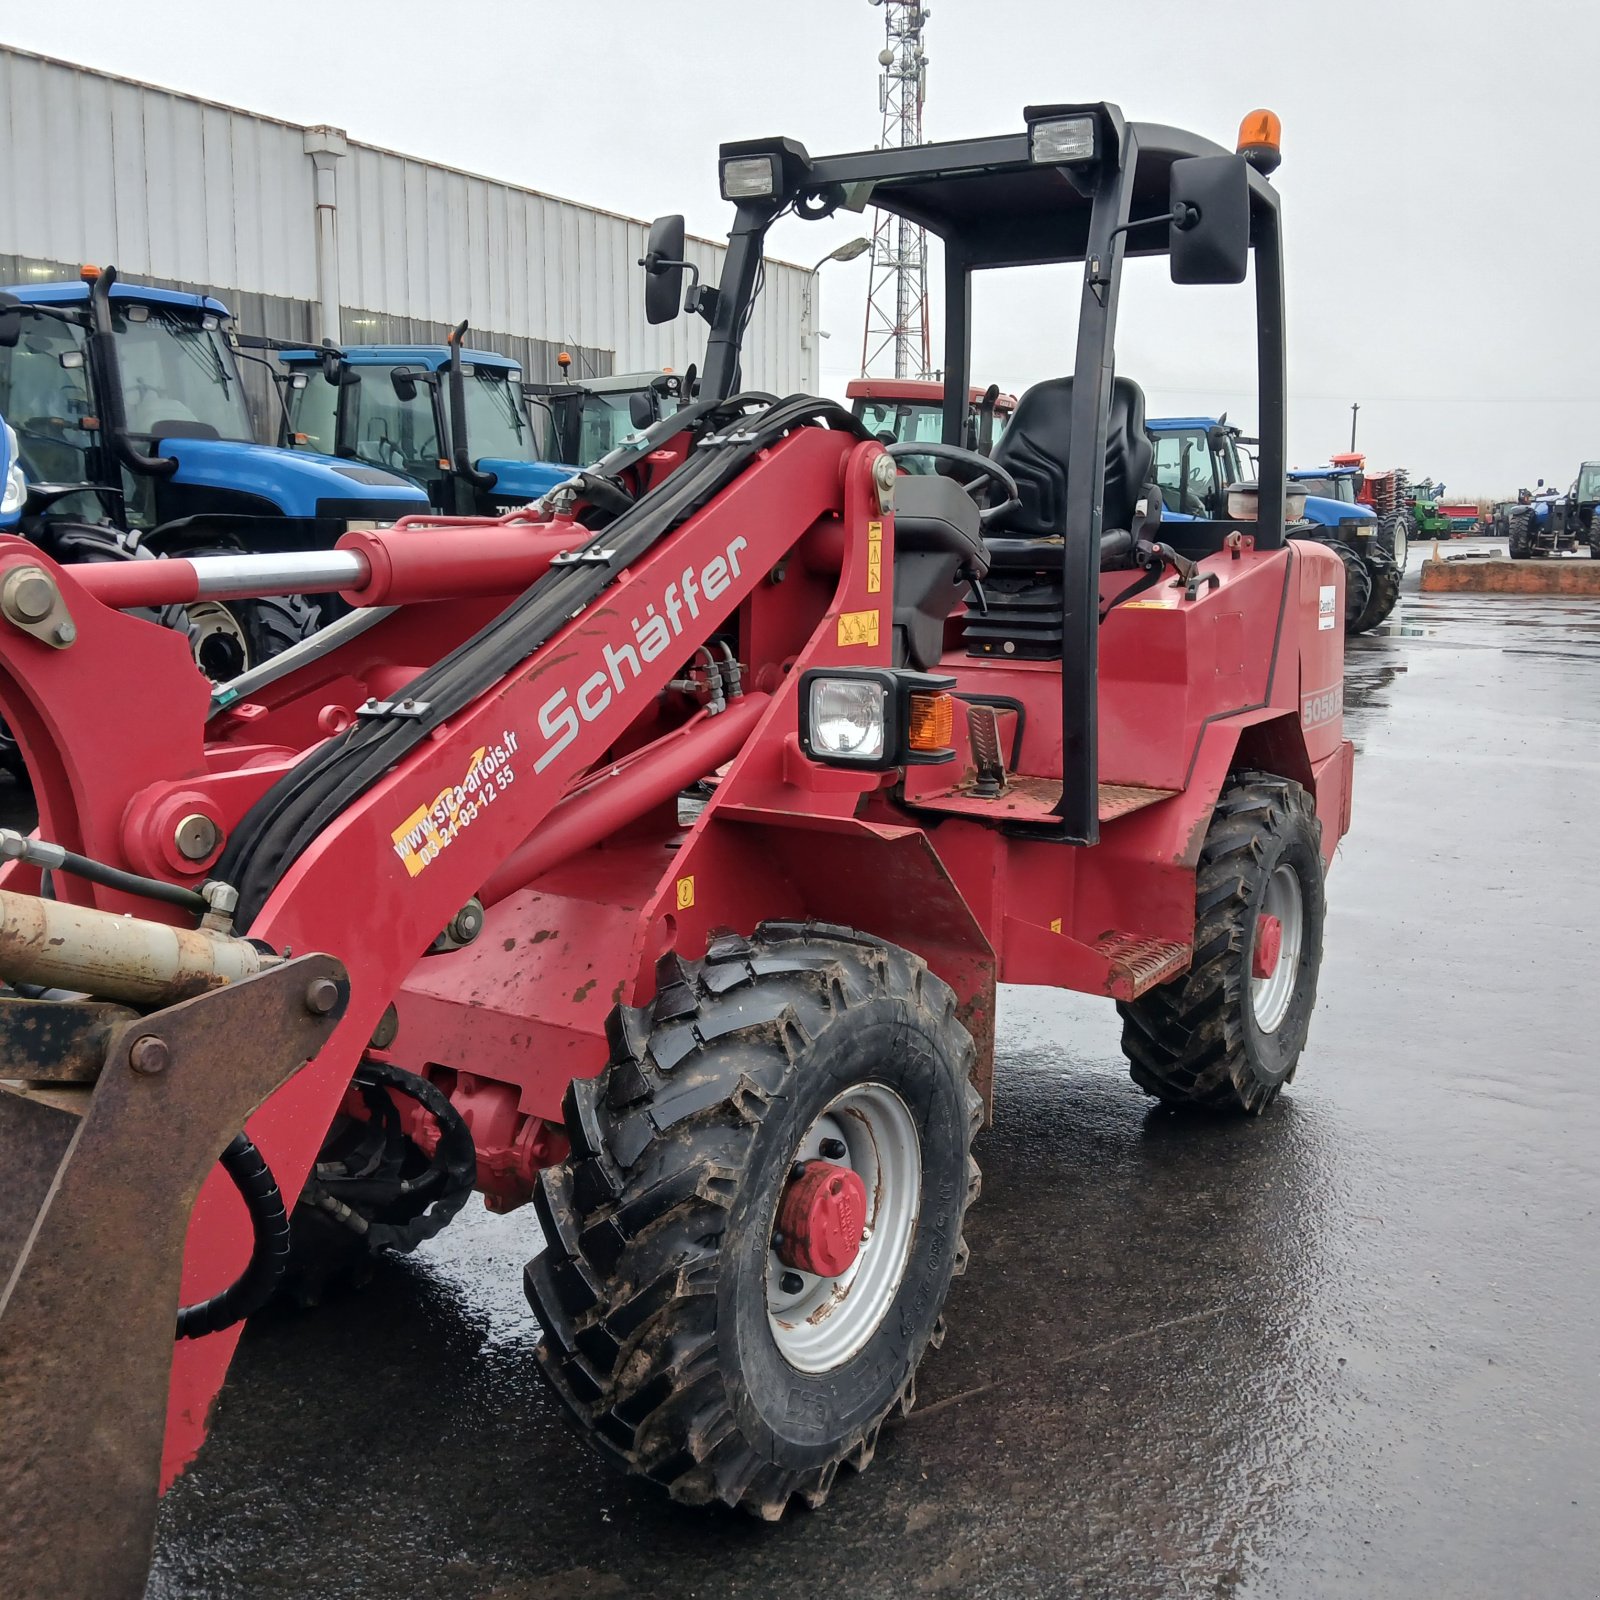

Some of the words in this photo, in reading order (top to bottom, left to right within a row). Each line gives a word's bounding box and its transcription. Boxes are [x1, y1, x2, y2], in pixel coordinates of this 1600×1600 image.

[532, 535, 748, 775] Schäffer
[393, 730, 519, 861] www.sica-artois.fr
[419, 840, 440, 866] 03
[439, 820, 459, 847] 21
[458, 801, 479, 827] 03
[478, 782, 498, 807] 12
[495, 764, 515, 791] 55
